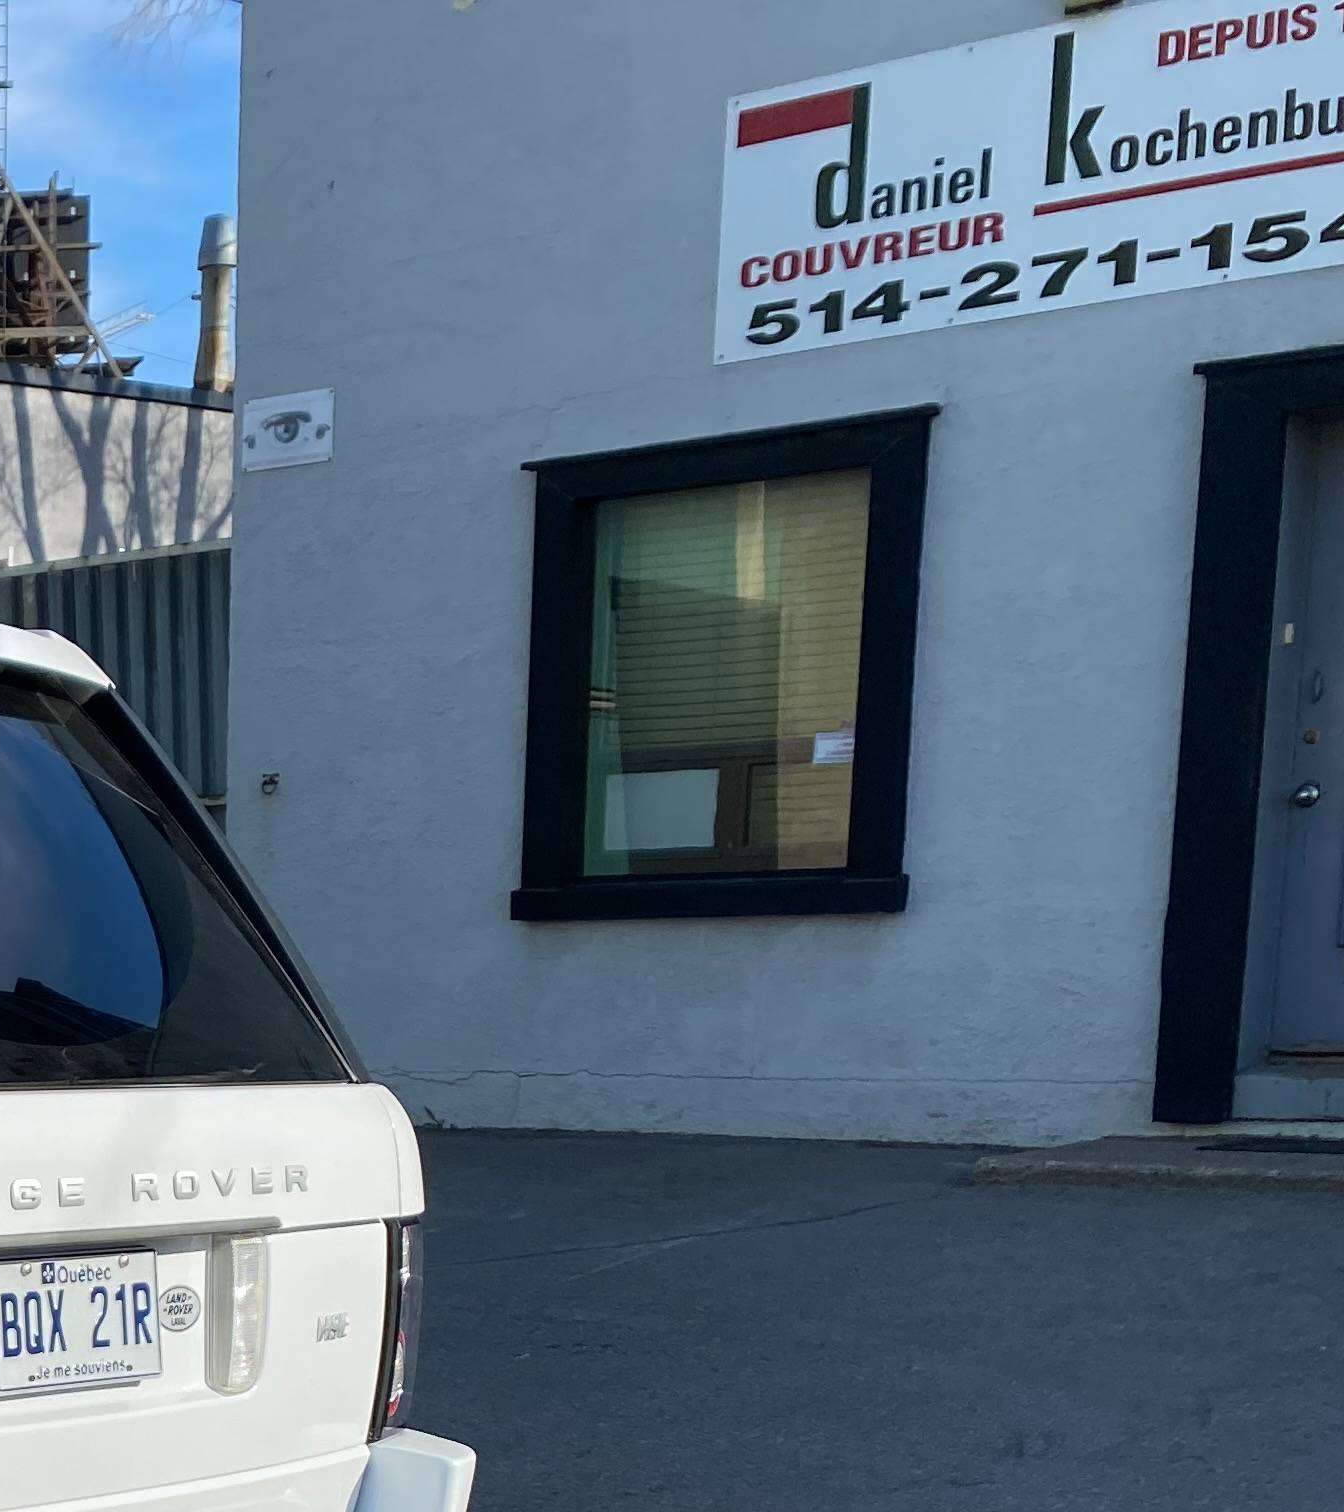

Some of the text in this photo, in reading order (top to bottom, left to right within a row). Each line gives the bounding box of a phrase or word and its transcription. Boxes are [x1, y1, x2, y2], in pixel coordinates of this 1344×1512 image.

[1158, 3, 1317, 67] DEPUIS
[740, 212, 1004, 289] COUVREUR
[131, 1164, 308, 1202] ROVER
[0, 1282, 152, 1357] BQX 21R
[36, 1360, 126, 1379] Je me souviens
